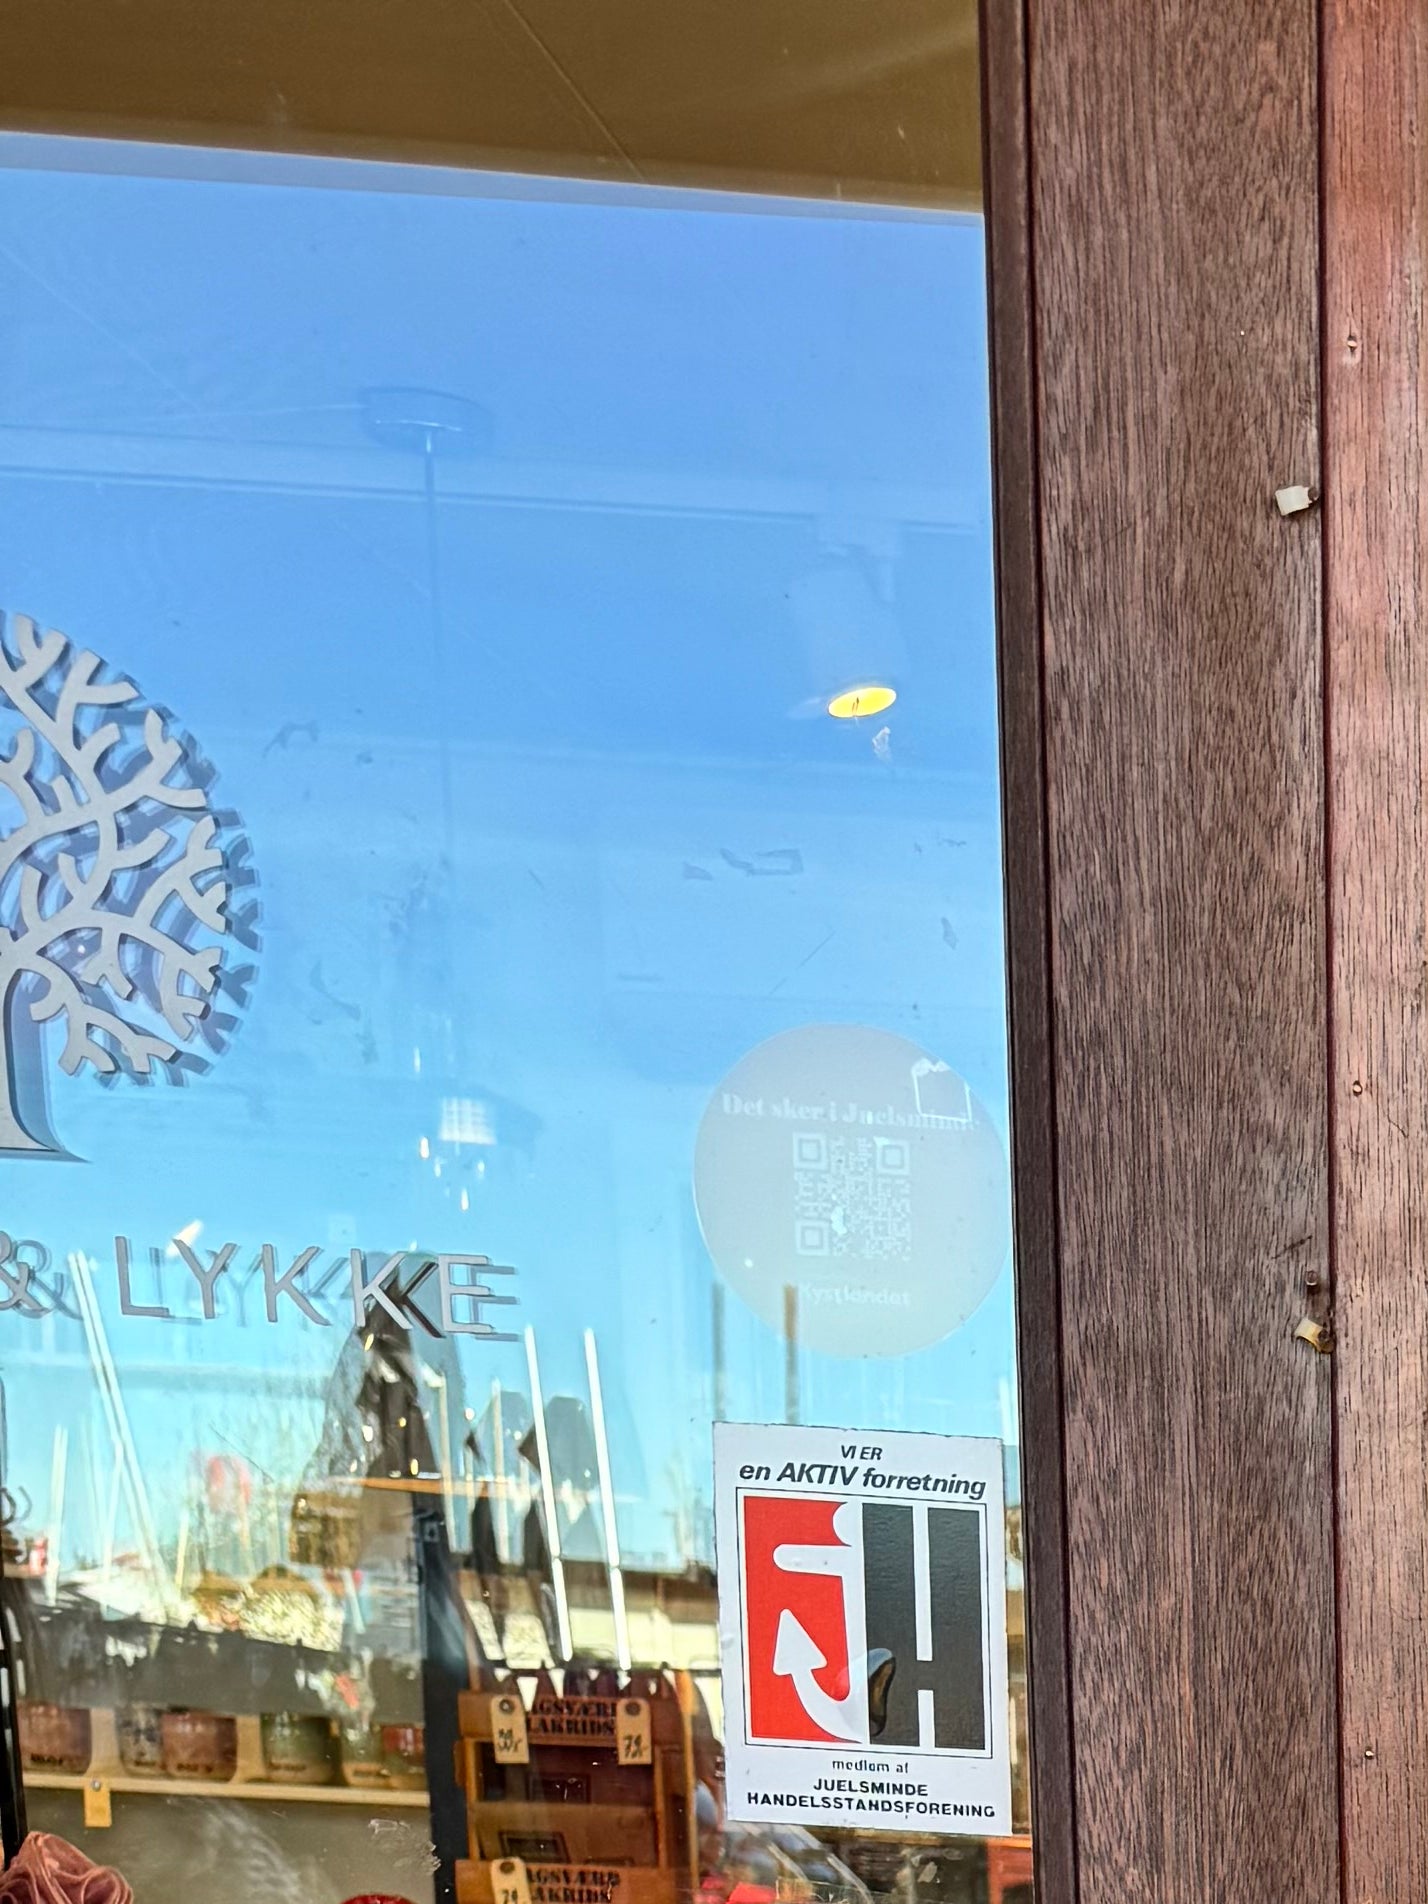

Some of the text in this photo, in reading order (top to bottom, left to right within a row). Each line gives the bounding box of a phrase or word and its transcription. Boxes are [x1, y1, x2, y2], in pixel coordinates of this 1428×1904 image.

[115, 1236, 494, 1334] LYKKE
[840, 1444, 883, 1461] VI ER
[739, 1462, 987, 1499] en AKTIV forretning
[813, 1778, 929, 1797] JUELSMINDE
[747, 1791, 996, 1818] HANDELSSTANDSFORENING
